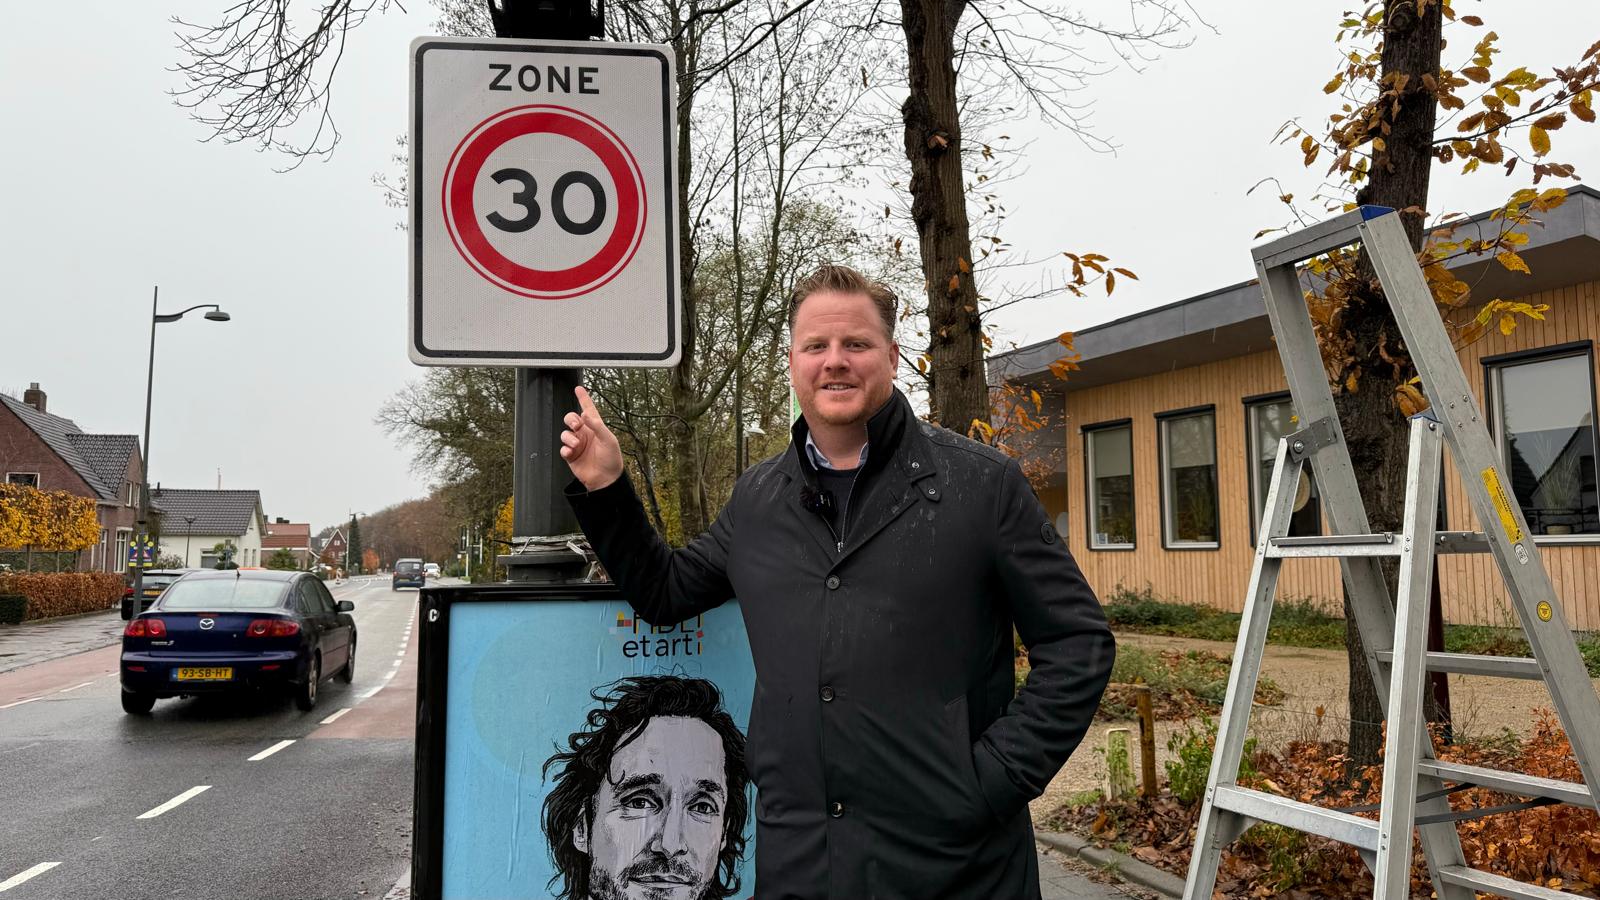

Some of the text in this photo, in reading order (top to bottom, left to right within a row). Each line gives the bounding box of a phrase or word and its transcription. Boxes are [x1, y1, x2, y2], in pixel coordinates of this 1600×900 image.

[488, 63, 600, 95] ZONE
[485, 167, 607, 236] 30
[181, 668, 229, 678] 93-SB-HT
